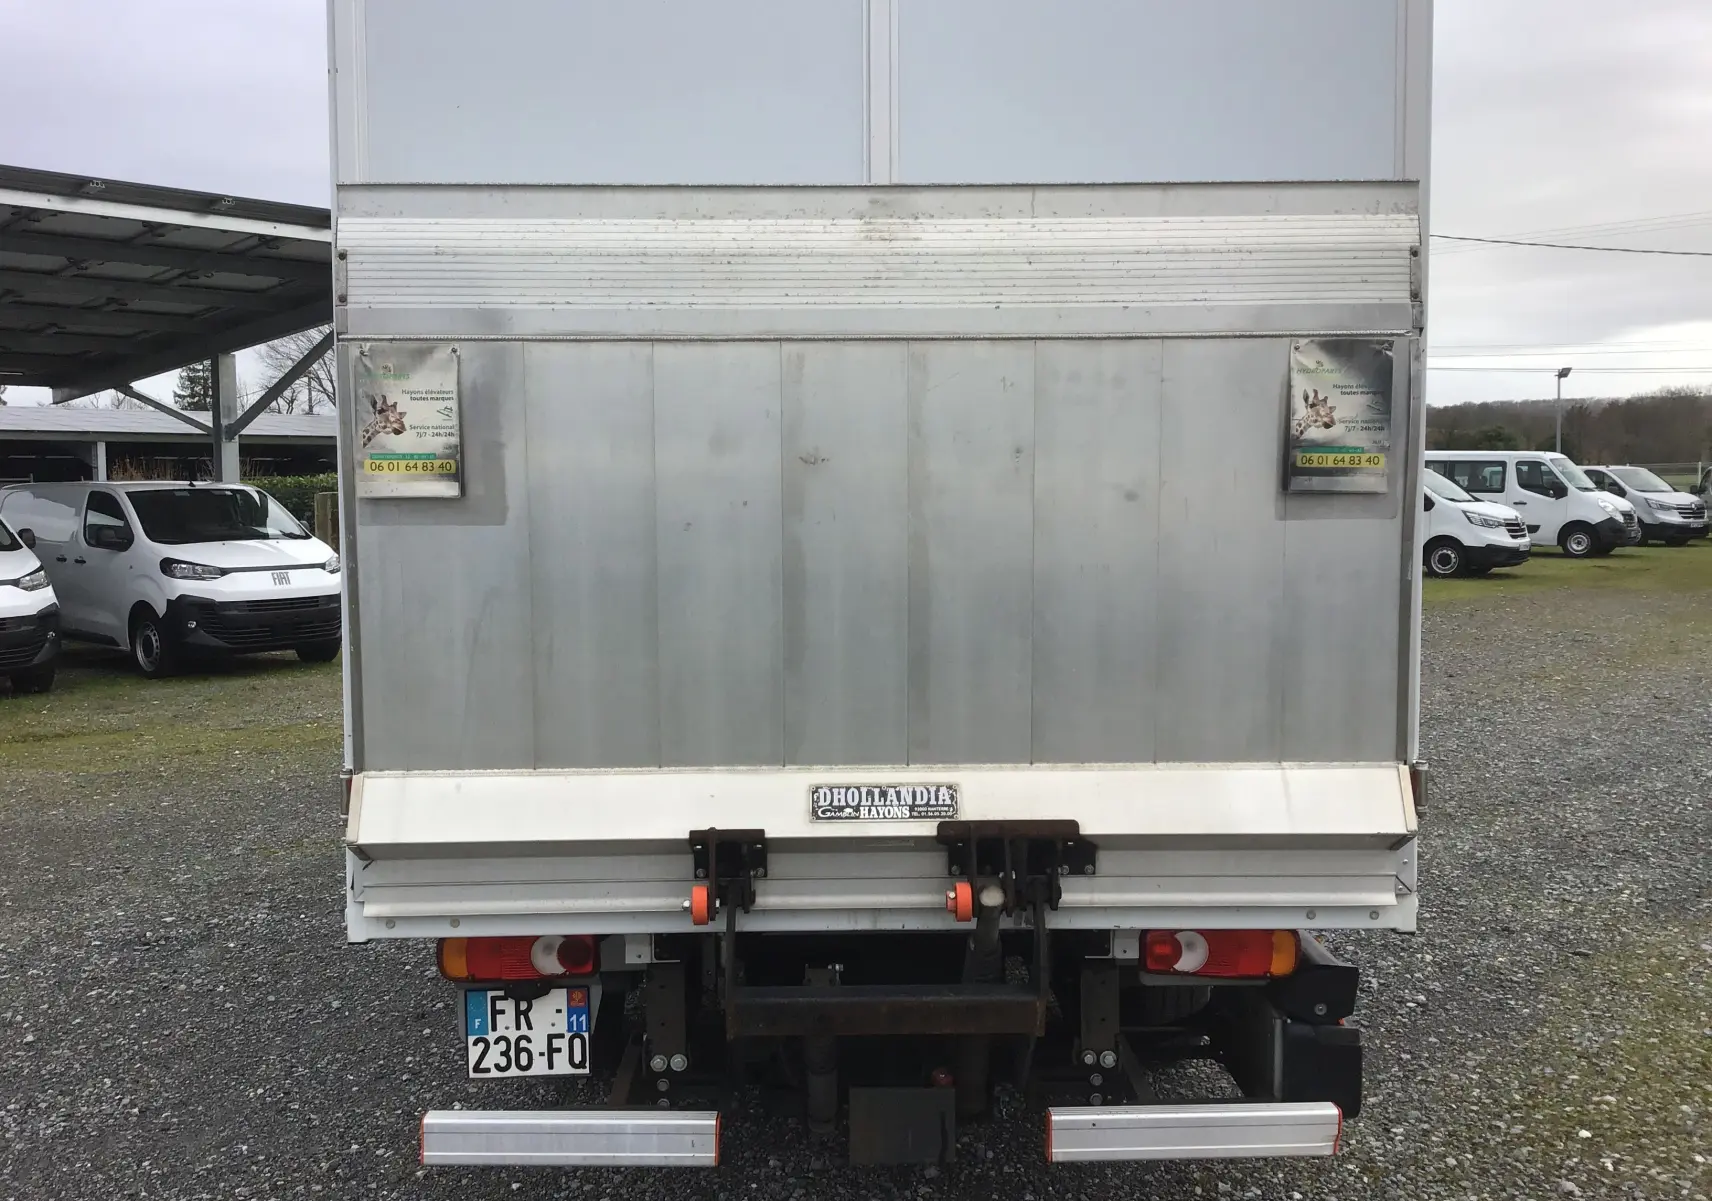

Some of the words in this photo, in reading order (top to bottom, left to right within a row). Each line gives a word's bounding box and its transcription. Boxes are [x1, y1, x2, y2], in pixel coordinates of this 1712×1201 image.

[370, 461, 384, 472] 06
[387, 461, 400, 472] 01
[405, 461, 418, 472] 64
[421, 461, 434, 472] 83
[438, 461, 452, 472] 40
[1301, 455, 1314, 466] 06
[1317, 455, 1328, 466] 01
[1333, 455, 1345, 466] 64
[1348, 455, 1361, 466] 83
[1365, 455, 1380, 466] 40
[271, 571, 291, 585] FIAT
[817, 786, 952, 806] DHOLLANDIA
[859, 806, 910, 819] HAYONS
[475, 1018, 481, 1029] F
[569, 1014, 587, 1031] 11
[472, 1033, 588, 1074] 236-FQ
